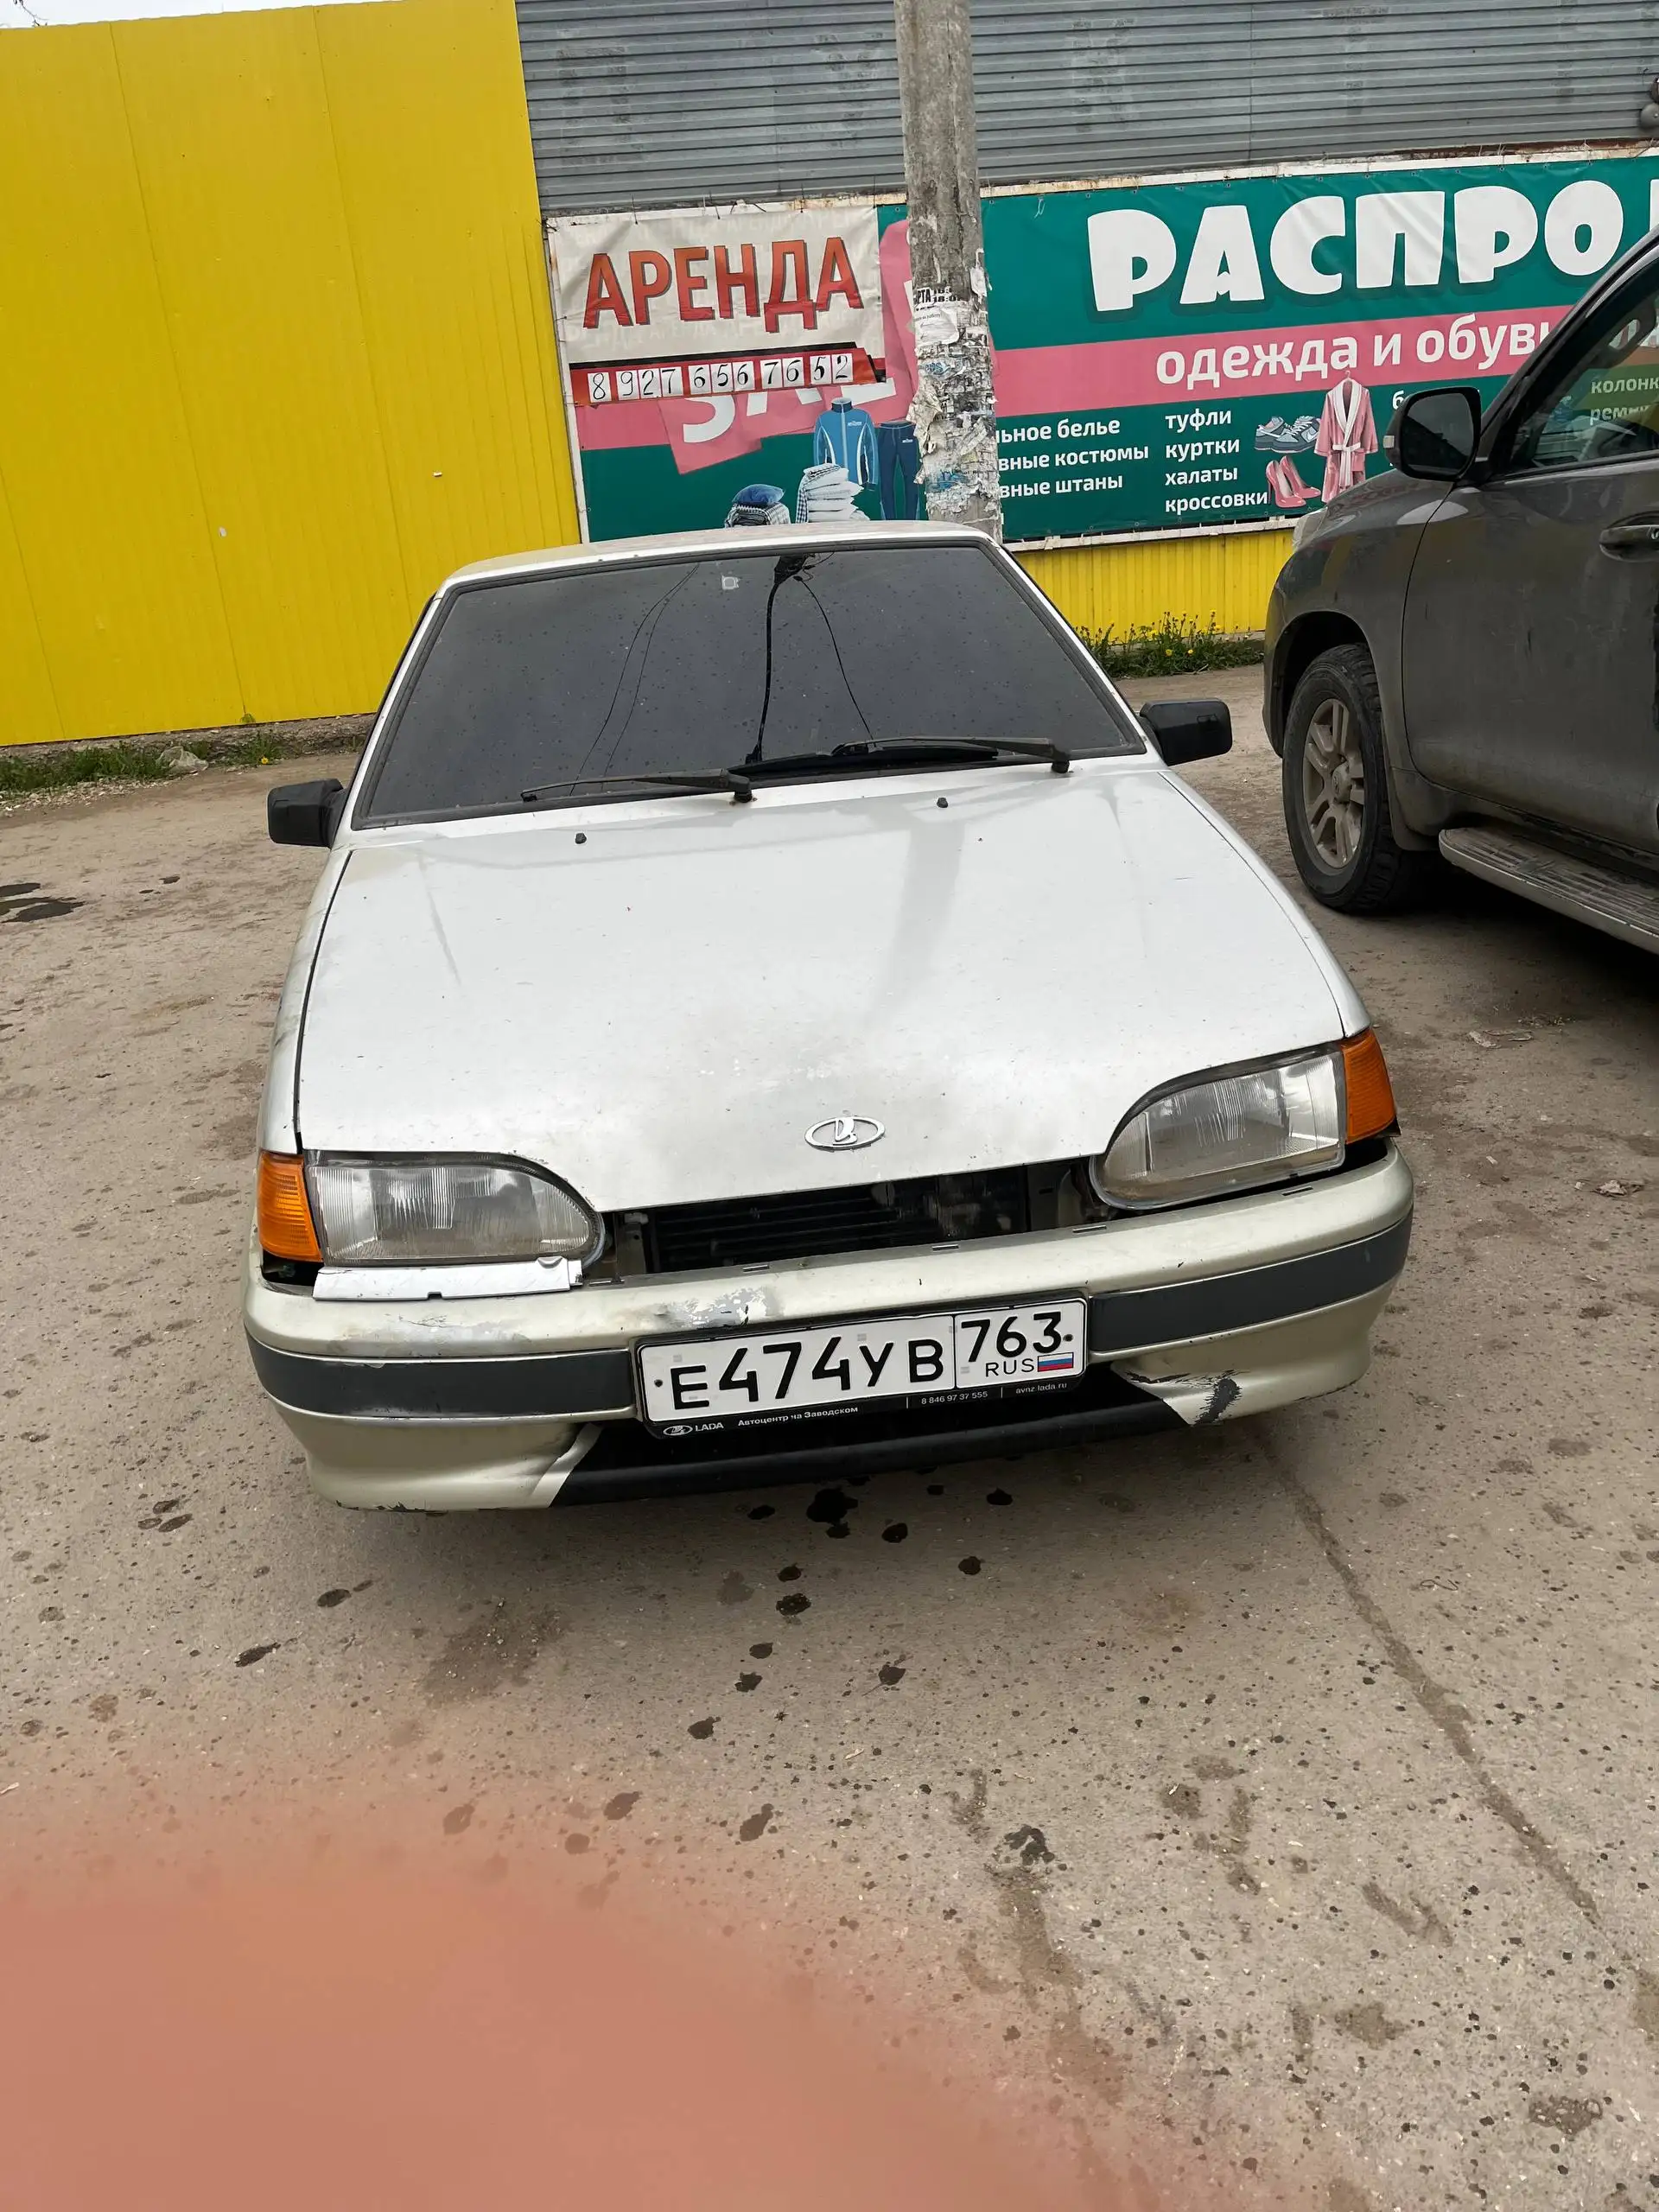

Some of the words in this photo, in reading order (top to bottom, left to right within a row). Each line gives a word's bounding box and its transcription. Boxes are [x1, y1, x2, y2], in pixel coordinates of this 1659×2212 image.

[1087, 180, 1659, 312] РАСПРО
[582, 237, 864, 333] АРЕНДА
[1156, 335, 1358, 391] одежда
[1373, 333, 1401, 366] и
[589, 372, 607, 400] 8
[620, 368, 676, 397] 927
[694, 363, 747, 388] 656
[764, 359, 801, 385] 76
[813, 353, 849, 381] 52
[1057, 418, 1120, 440] белье
[1165, 408, 1231, 433] туфли
[999, 454, 1050, 472] вные
[1055, 445, 1148, 467] костюмы
[1166, 438, 1240, 461] куртки
[999, 481, 1051, 499] вные
[1055, 475, 1123, 493] штаны
[1165, 467, 1237, 486] халаты
[1165, 491, 1268, 515] кроссовки
[960, 1311, 1062, 1363] 763
[985, 1358, 1035, 1377] RUS
[921, 1396, 927, 1405] 8
[929, 1395, 945, 1404] 846
[948, 1394, 958, 1402] 97
[971, 1390, 988, 1399] 555
[695, 1422, 724, 1433] LADA
[738, 1414, 789, 1427] Автоцентр
[804, 1407, 858, 1419] Заводском
